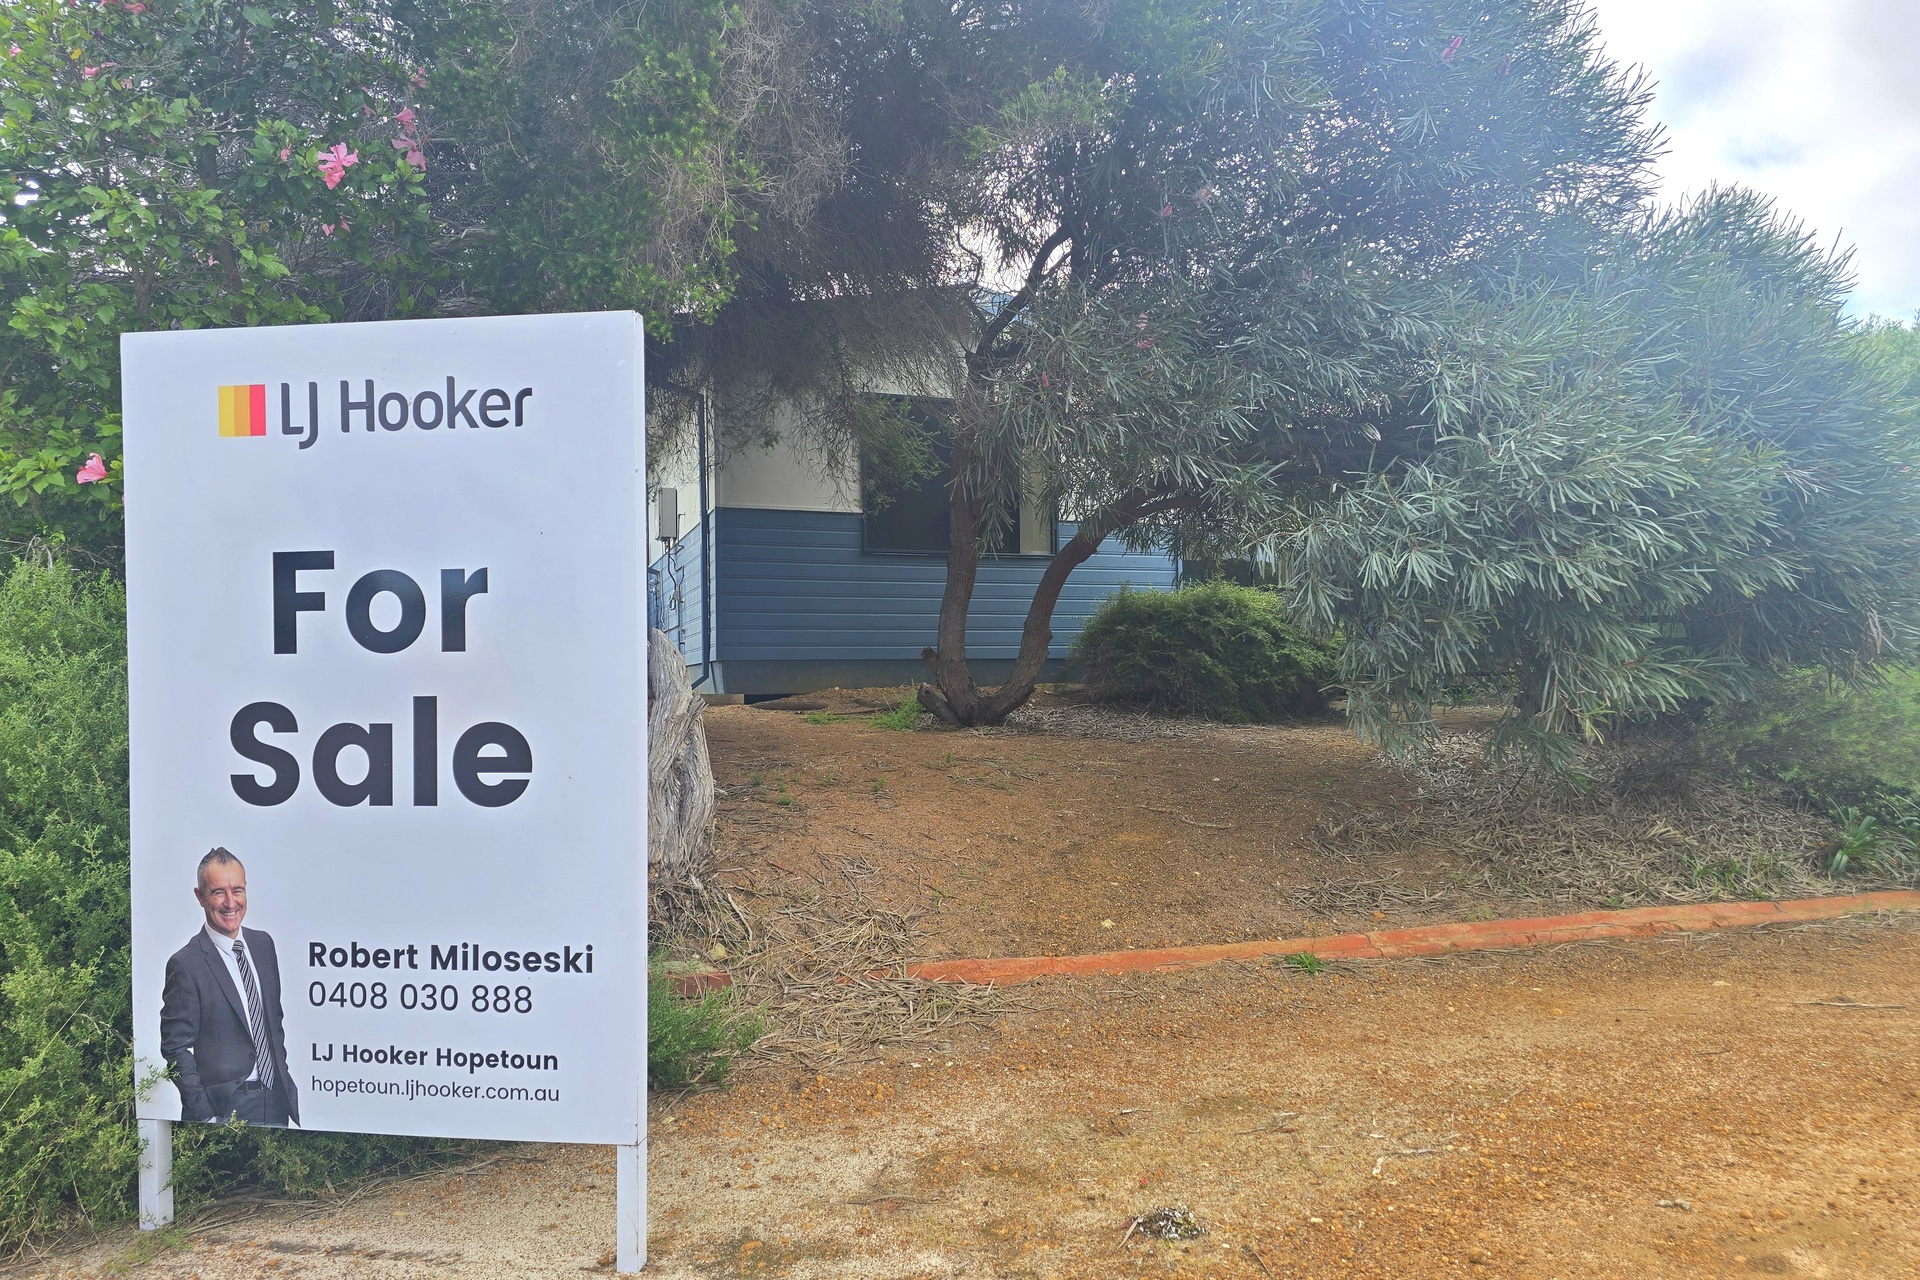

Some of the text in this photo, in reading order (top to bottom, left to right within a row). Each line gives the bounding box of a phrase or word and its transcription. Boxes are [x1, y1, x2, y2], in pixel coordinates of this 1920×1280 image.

[281, 375, 533, 449] LJ Hooker
[272, 549, 488, 654] For
[229, 695, 533, 807] Sale
[309, 941, 593, 973] Robert Miloseski
[309, 980, 532, 1013] 0408 030 888
[311, 1042, 557, 1074] LJ Hooker Hopetoun
[311, 1074, 559, 1102] hopetoun.ljhooker.com.au
